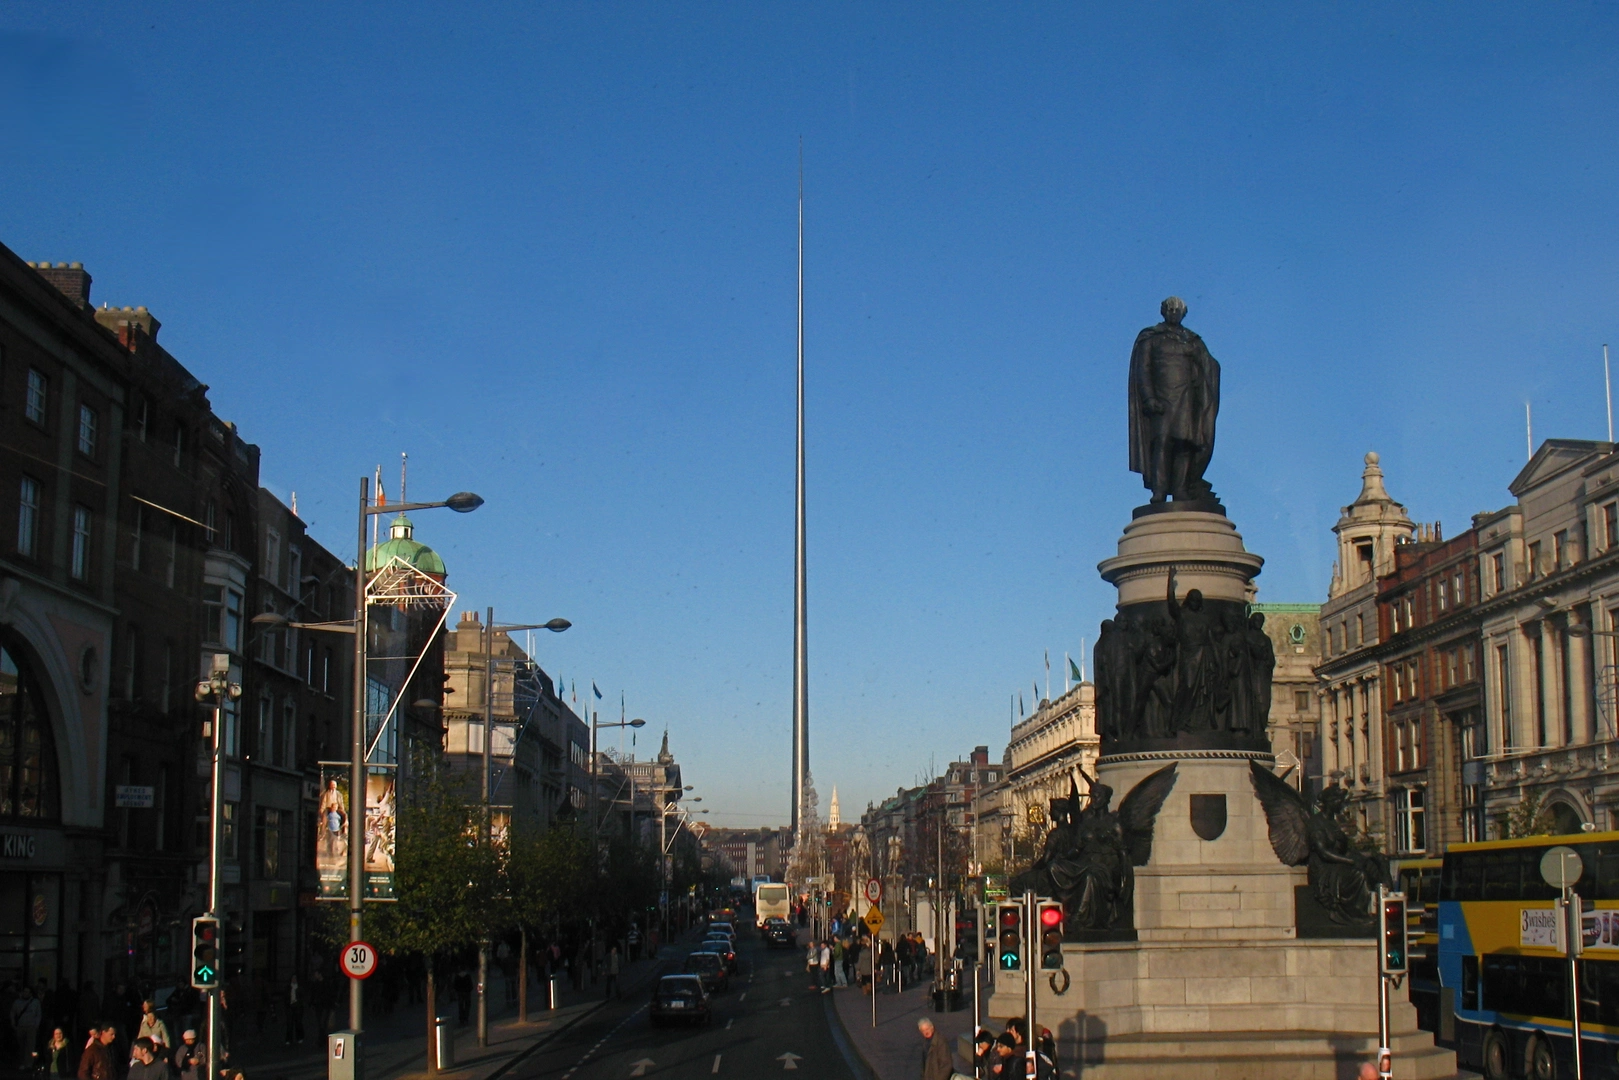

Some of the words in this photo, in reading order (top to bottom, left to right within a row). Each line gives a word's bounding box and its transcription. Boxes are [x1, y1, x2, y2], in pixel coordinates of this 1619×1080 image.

[3, 834, 36, 858] KING
[1522, 909, 1529, 932] 3
[351, 948, 366, 963] 30
